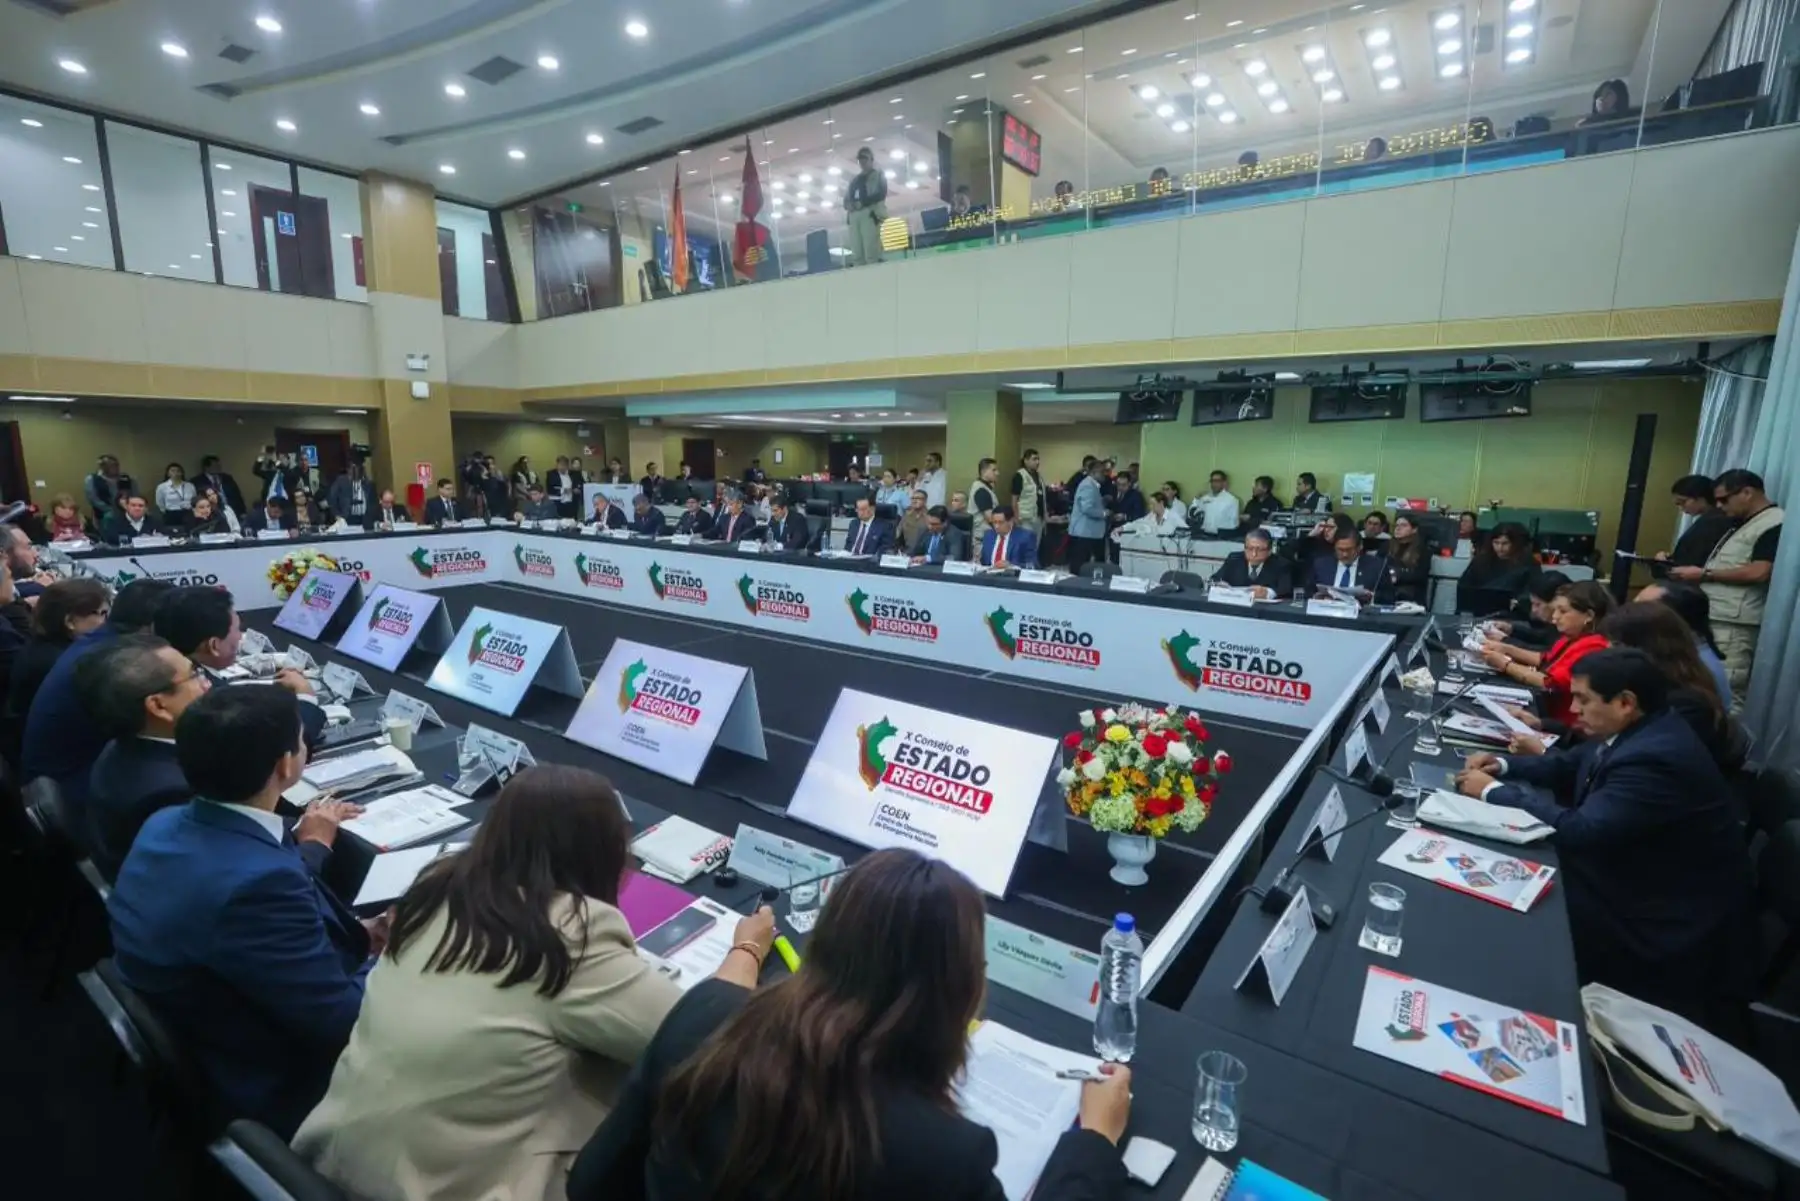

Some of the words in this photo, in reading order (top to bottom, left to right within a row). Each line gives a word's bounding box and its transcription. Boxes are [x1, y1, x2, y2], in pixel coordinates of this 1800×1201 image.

[433, 551, 481, 563] ESTADO
[526, 553, 551, 565] ESTADO
[589, 562, 620, 576] ESTADO
[167, 574, 218, 587] TADO
[665, 574, 702, 588] ESTADO
[758, 587, 804, 603] ESTADO
[384, 607, 413, 623] ESTADO
[760, 601, 808, 617] REGIONAL
[873, 603, 931, 623] ESTADO
[876, 619, 936, 638] REGIONAL
[1029, 616, 1060, 627] Consejo
[1019, 623, 1093, 647] ESTADO
[487, 636, 528, 656] ESTADO
[1022, 640, 1096, 664] REGIONAL
[1210, 640, 1216, 648] X
[1219, 641, 1260, 654] Consejo
[1263, 647, 1276, 656] de
[481, 651, 520, 671] REGIONAL
[1206, 650, 1303, 679] ESTADO
[642, 677, 702, 705] ESTADO
[1209, 671, 1306, 698] REGIONAL
[636, 695, 696, 723] REGIONAL
[905, 732, 913, 740] X
[915, 734, 954, 752] Consejo
[956, 746, 969, 756] de
[894, 743, 990, 786] ESTADO
[889, 767, 985, 811] REGIONAL
[881, 804, 911, 821] COEN
[1398, 990, 1412, 1025] ESTADO
